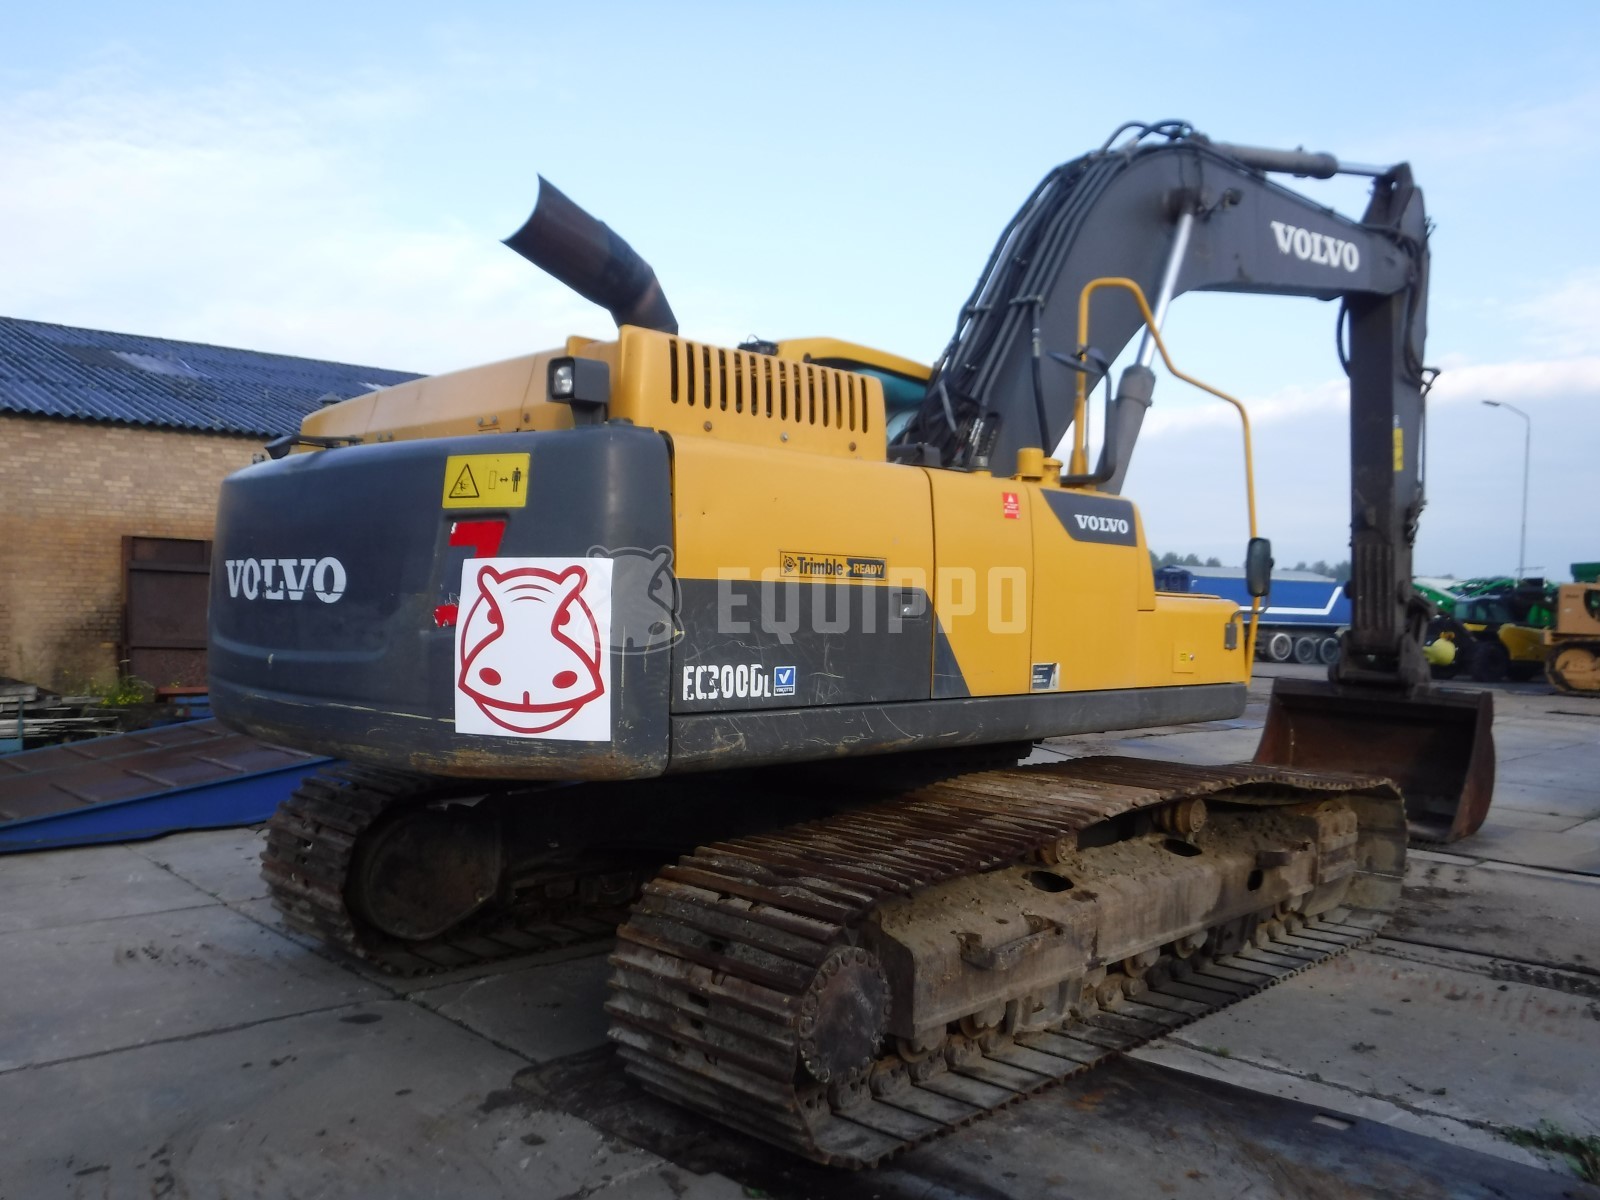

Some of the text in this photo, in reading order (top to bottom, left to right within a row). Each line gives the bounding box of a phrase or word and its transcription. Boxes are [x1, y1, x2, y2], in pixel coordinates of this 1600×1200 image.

[1270, 220, 1360, 273] VOLVO
[1074, 513, 1129, 535] VOLVO
[225, 556, 347, 604] VOLVO
[797, 556, 884, 576] Trimble READY
